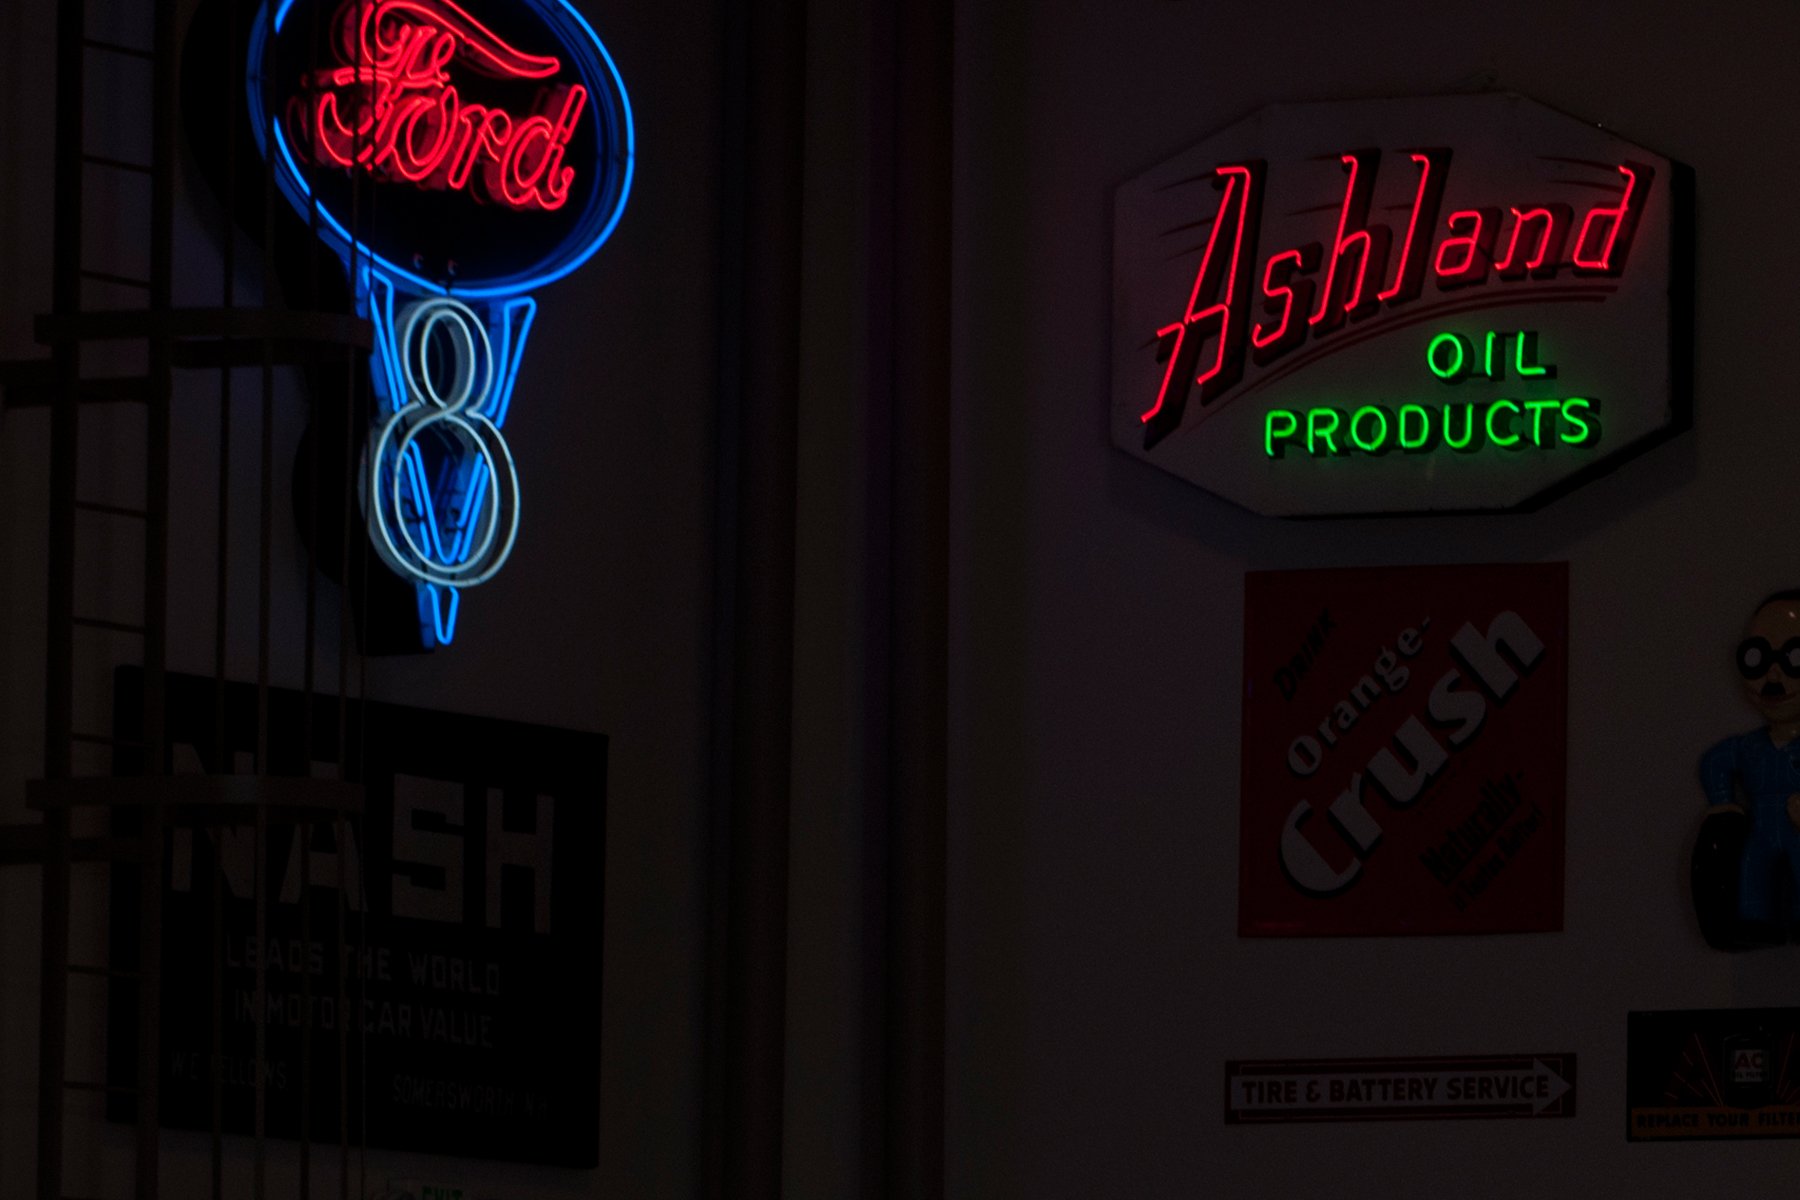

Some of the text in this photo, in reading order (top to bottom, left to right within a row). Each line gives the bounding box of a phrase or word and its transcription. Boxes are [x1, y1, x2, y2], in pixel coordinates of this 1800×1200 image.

[308, 0, 588, 210] Ford
[1141, 150, 1648, 432] Ashland
[1426, 330, 1548, 379] OIL
[1264, 398, 1592, 457] PRODUCTS
[1279, 609, 1547, 898] Crush
[164, 740, 556, 938] NASH
[225, 931, 326, 977] LEADS
[407, 950, 504, 997] WORLD
[357, 997, 413, 1039] CAR
[416, 1007, 496, 1049] VALUE
[1242, 1075, 1549, 1105] TIRE & BATTERY SERVICE
[1636, 1112, 1700, 1128] REPLACE
[1706, 1111, 1750, 1127] YOUR
